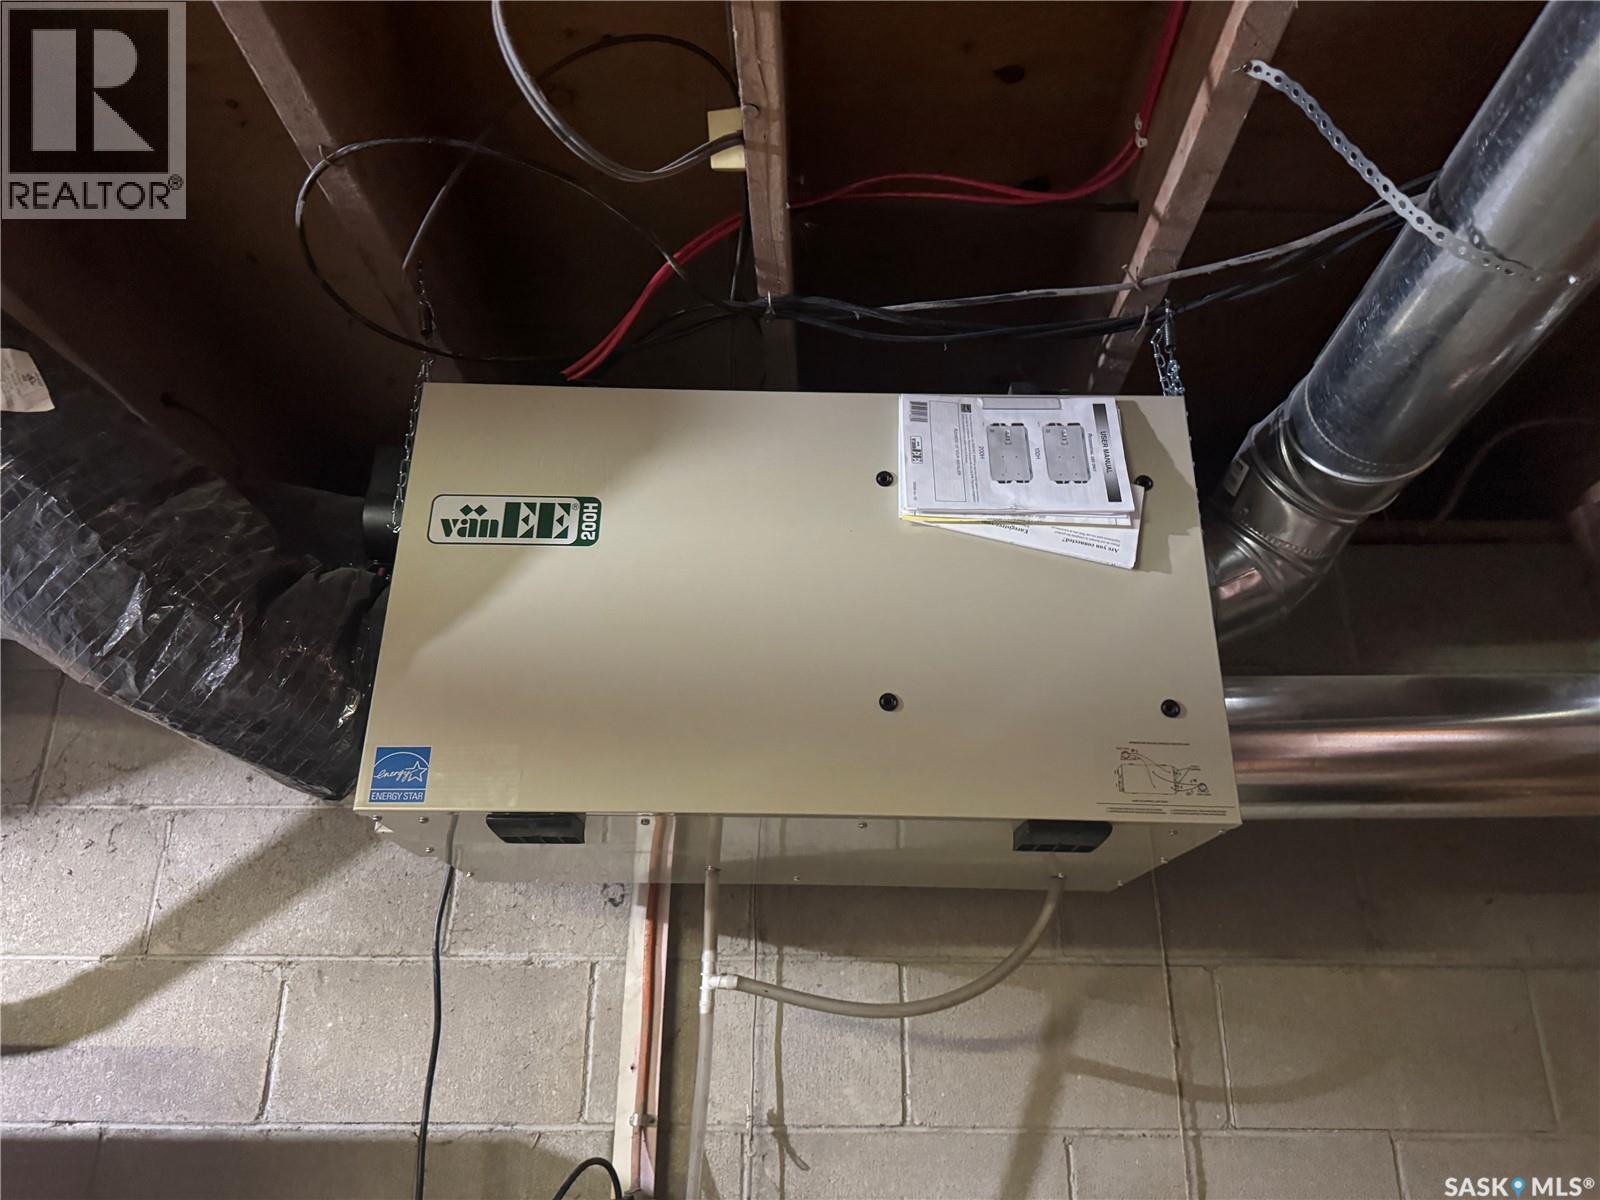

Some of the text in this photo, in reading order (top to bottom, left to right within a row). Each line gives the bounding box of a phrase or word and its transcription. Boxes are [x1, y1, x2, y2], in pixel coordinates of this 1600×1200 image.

[1100, 430, 1113, 474] USER MANUAL
[581, 502, 599, 541] 200H
[1061, 537, 1095, 547] connected?
[371, 791, 424, 801] ENERGY STAR
